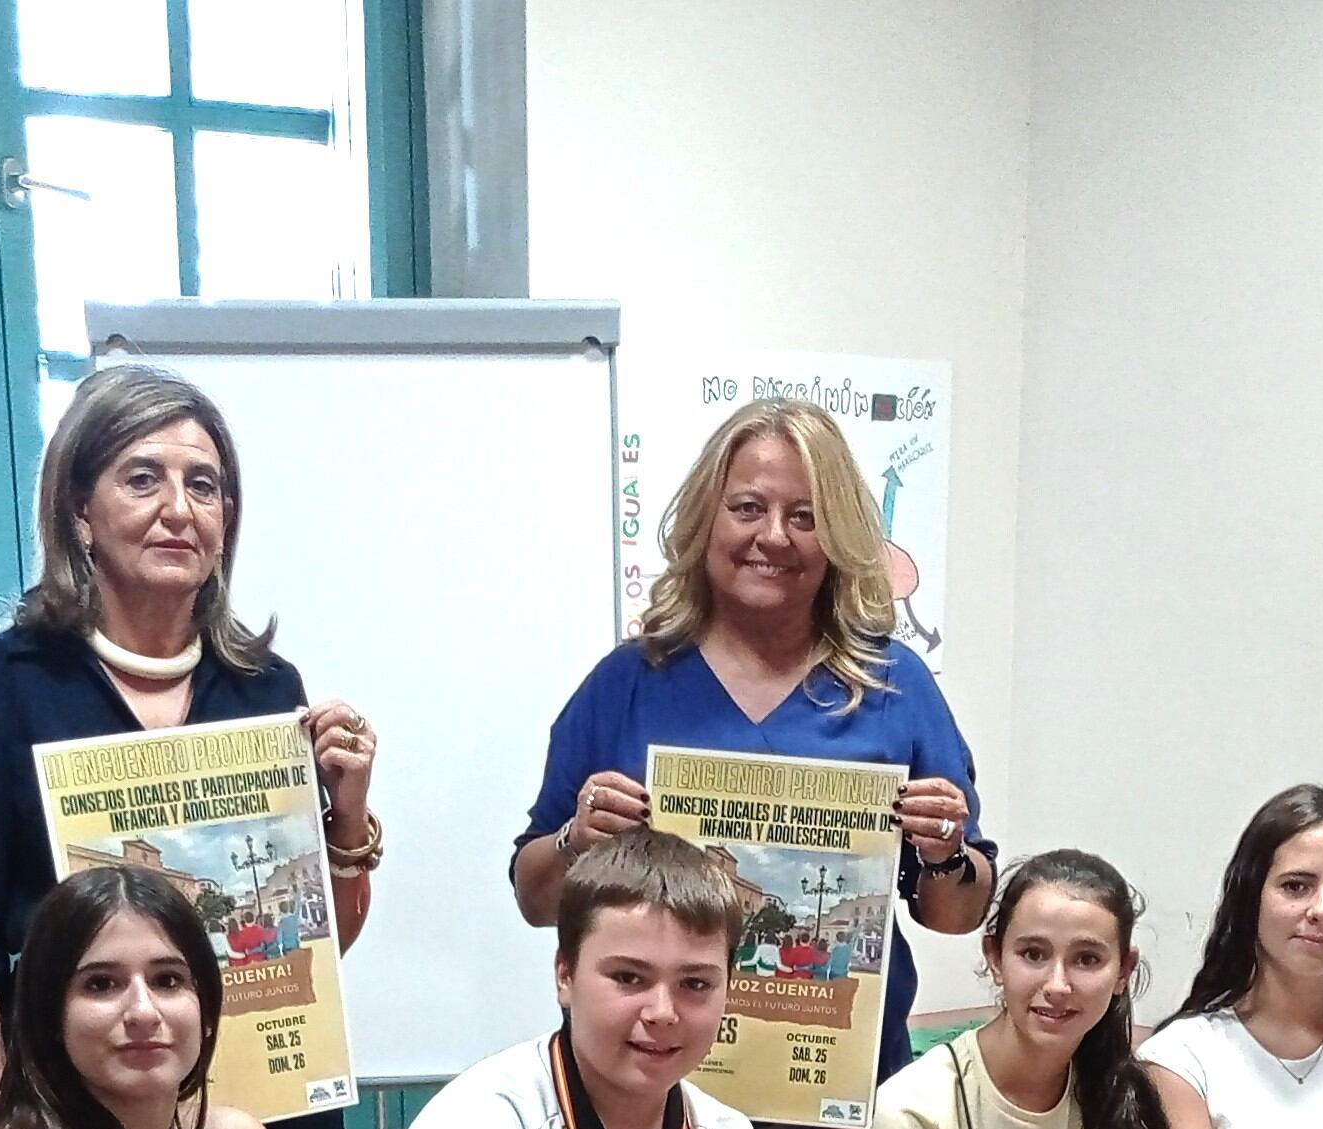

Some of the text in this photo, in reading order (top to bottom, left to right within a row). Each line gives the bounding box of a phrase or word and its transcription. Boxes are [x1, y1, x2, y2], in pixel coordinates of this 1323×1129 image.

[702, 375, 738, 404] NO
[70, 739, 190, 786] ENCUENTRO
[193, 724, 308, 773] PROVINCIAL
[677, 757, 786, 797] ENCUENTRO
[60, 764, 309, 817] CONSEJOS LOCALES DE PARTICIPACIÓN DE
[109, 792, 271, 833] INFANCIA Y ADOLESCENCIA
[660, 794, 718, 817] CONSEJOS
[720, 799, 770, 822] LOCALES
[772, 804, 788, 823] DE
[789, 805, 878, 832] PARTICIPACIÓN
[698, 817, 851, 850] INFANCIA Y ADOLESCENCIA
[222, 963, 293, 987] CUENTA!
[729, 978, 834, 1000] VOZ CUENTA!
[256, 1014, 307, 1032] OCTUBRE
[288, 1030, 302, 1047] 25
[786, 1032, 837, 1046] OCTUBRE
[268, 1052, 306, 1075] DOM. 26
[815, 1048, 828, 1064] 25
[789, 1067, 827, 1085] DOM. 26
